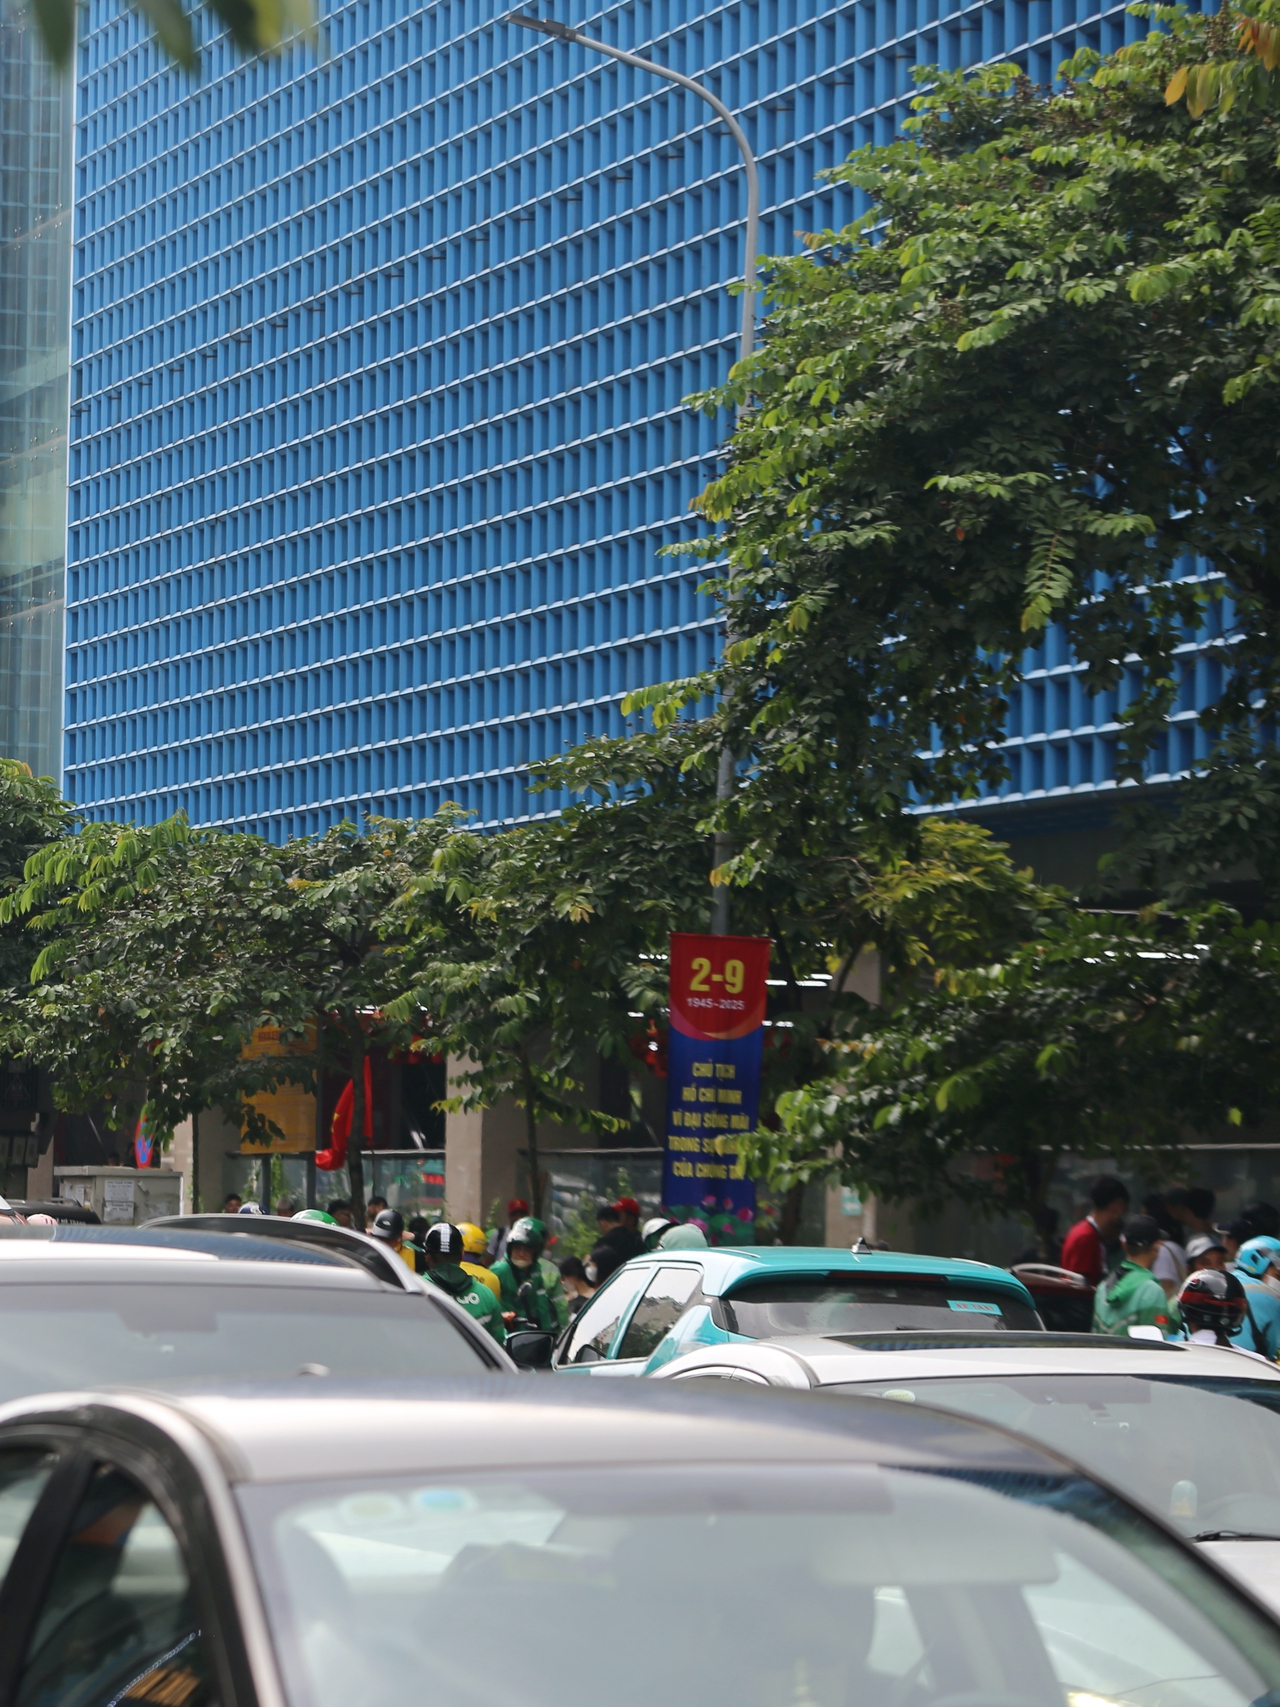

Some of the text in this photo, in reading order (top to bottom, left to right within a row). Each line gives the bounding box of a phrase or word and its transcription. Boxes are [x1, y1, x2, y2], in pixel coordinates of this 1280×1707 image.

[690, 957, 745, 994] 2-9
[686, 997, 745, 1010] 1945-2025
[682, 1083, 697, 1101] HỒ
